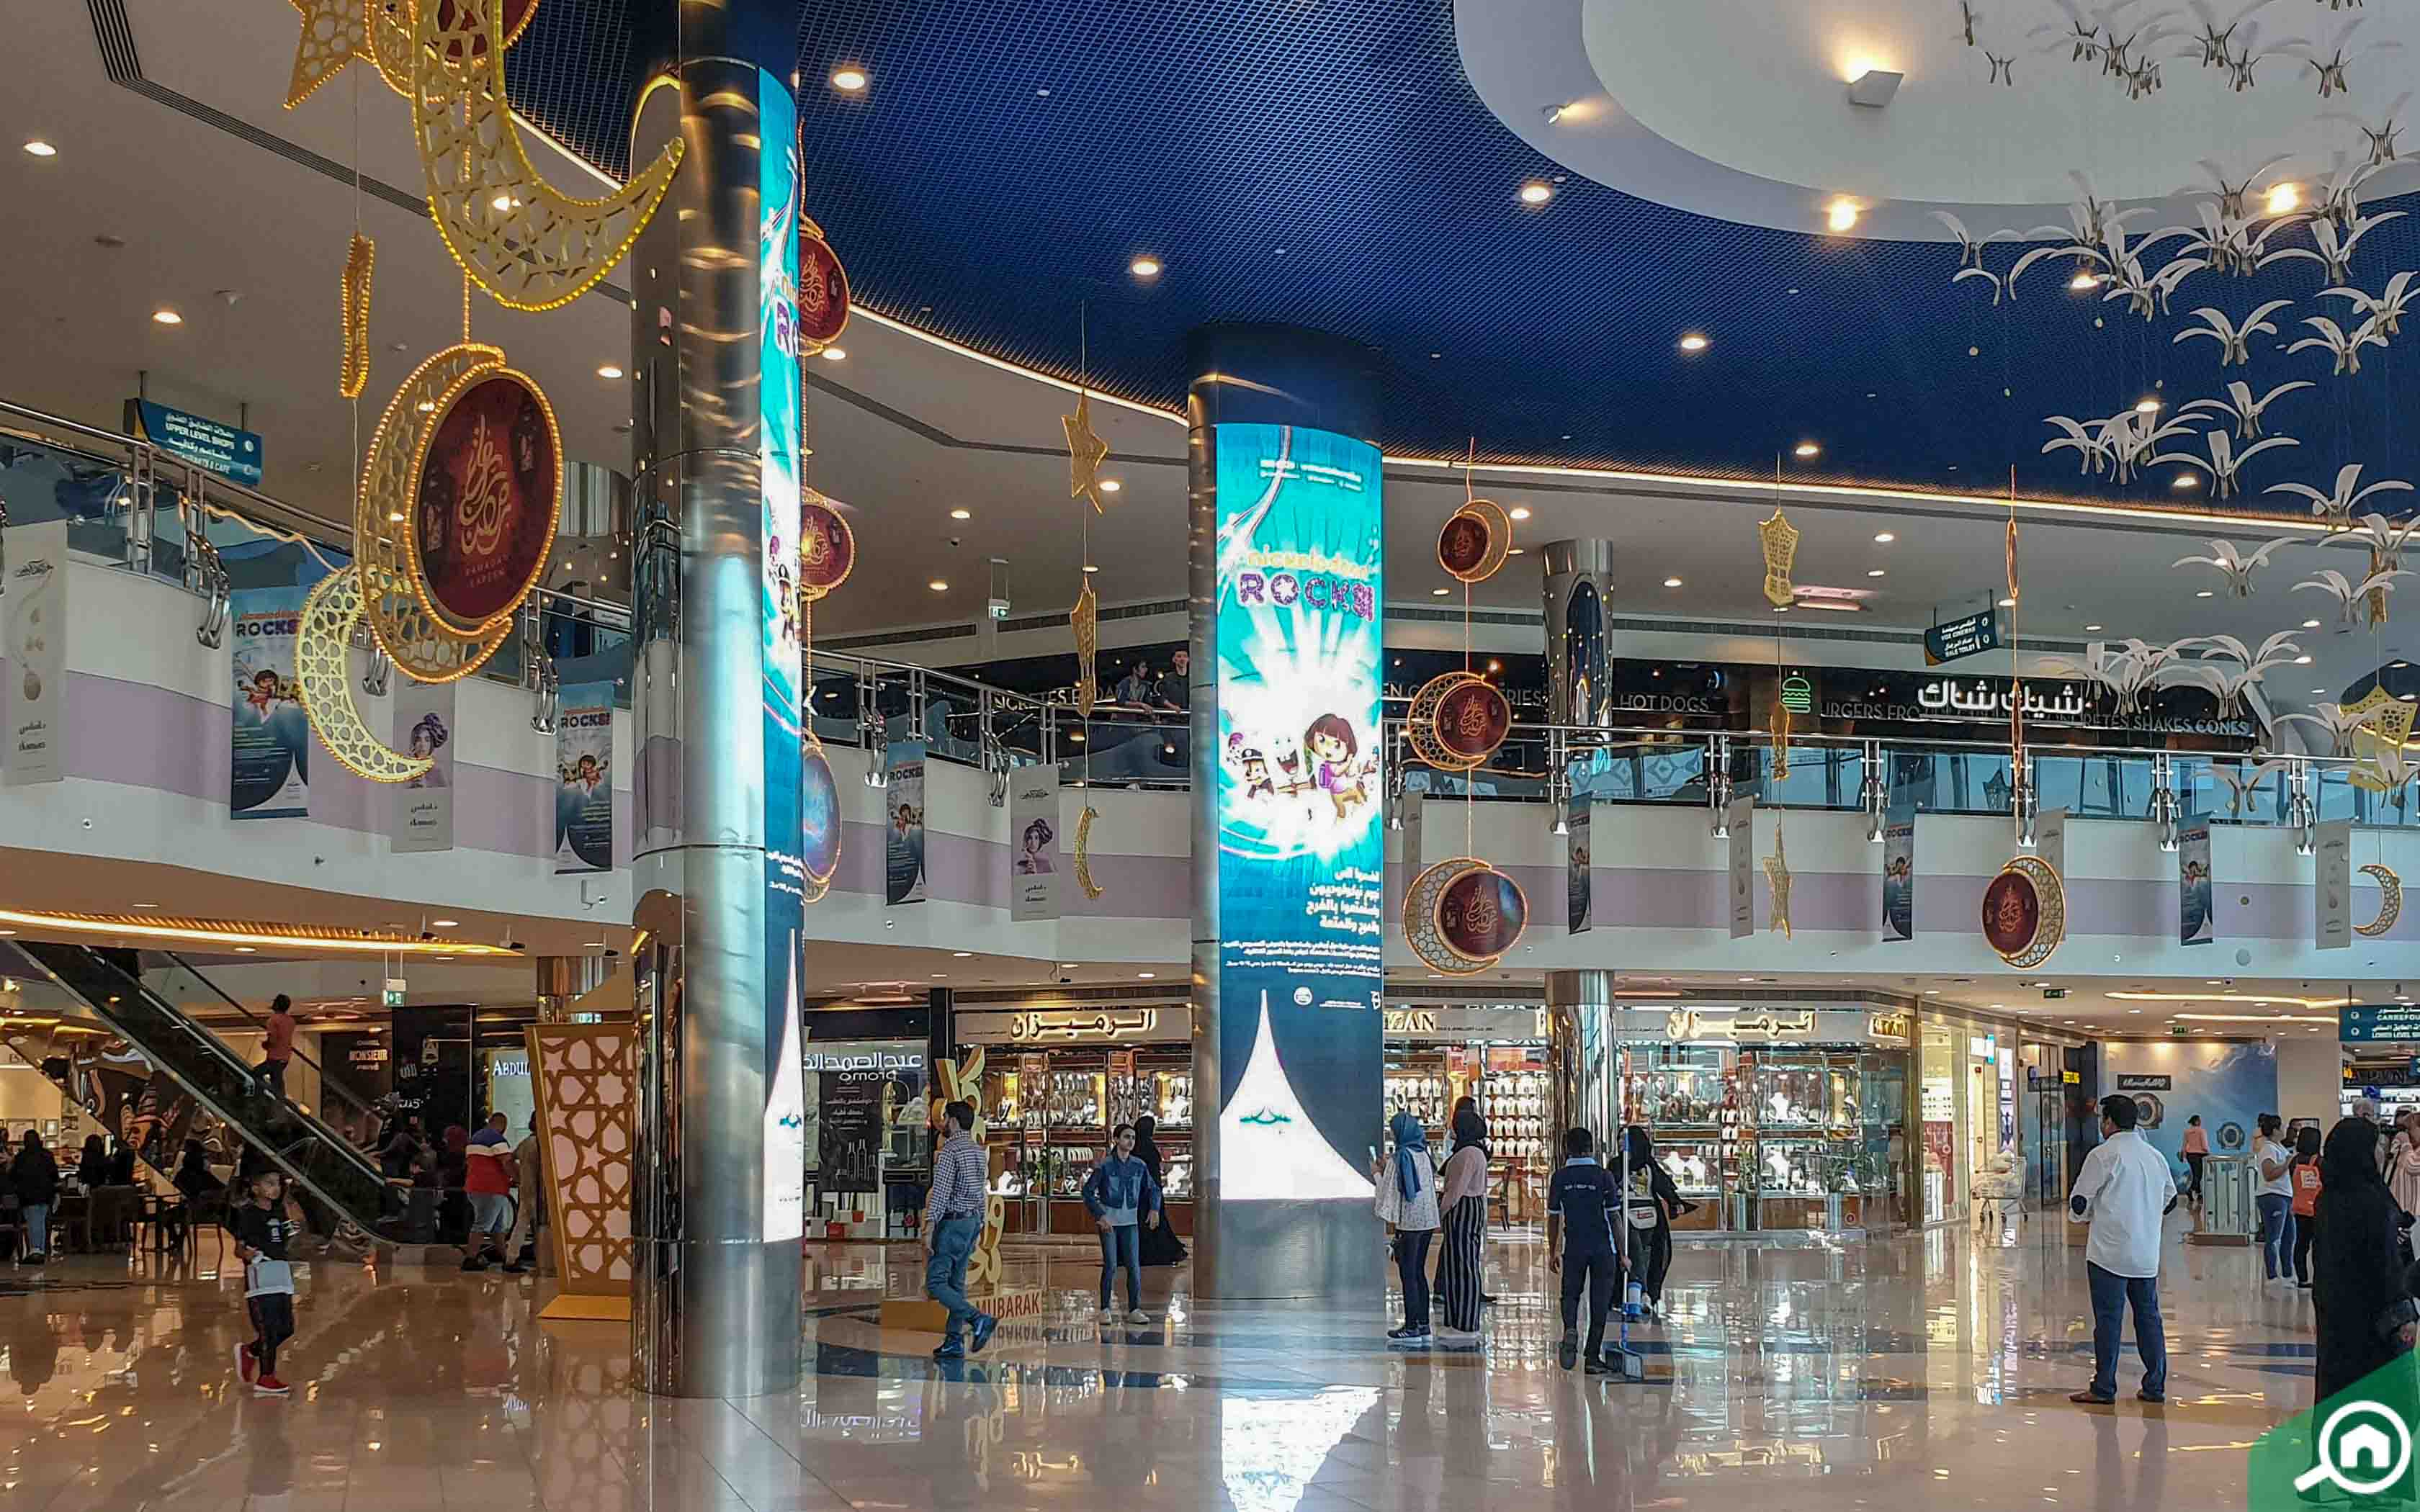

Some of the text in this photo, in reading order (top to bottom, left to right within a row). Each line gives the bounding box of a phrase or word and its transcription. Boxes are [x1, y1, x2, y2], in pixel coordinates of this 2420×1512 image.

[1621, 694, 1710, 712] HOT DOGS
[1918, 678, 1997, 711] شاك
[1010, 1008, 1157, 1040] الرميزان
